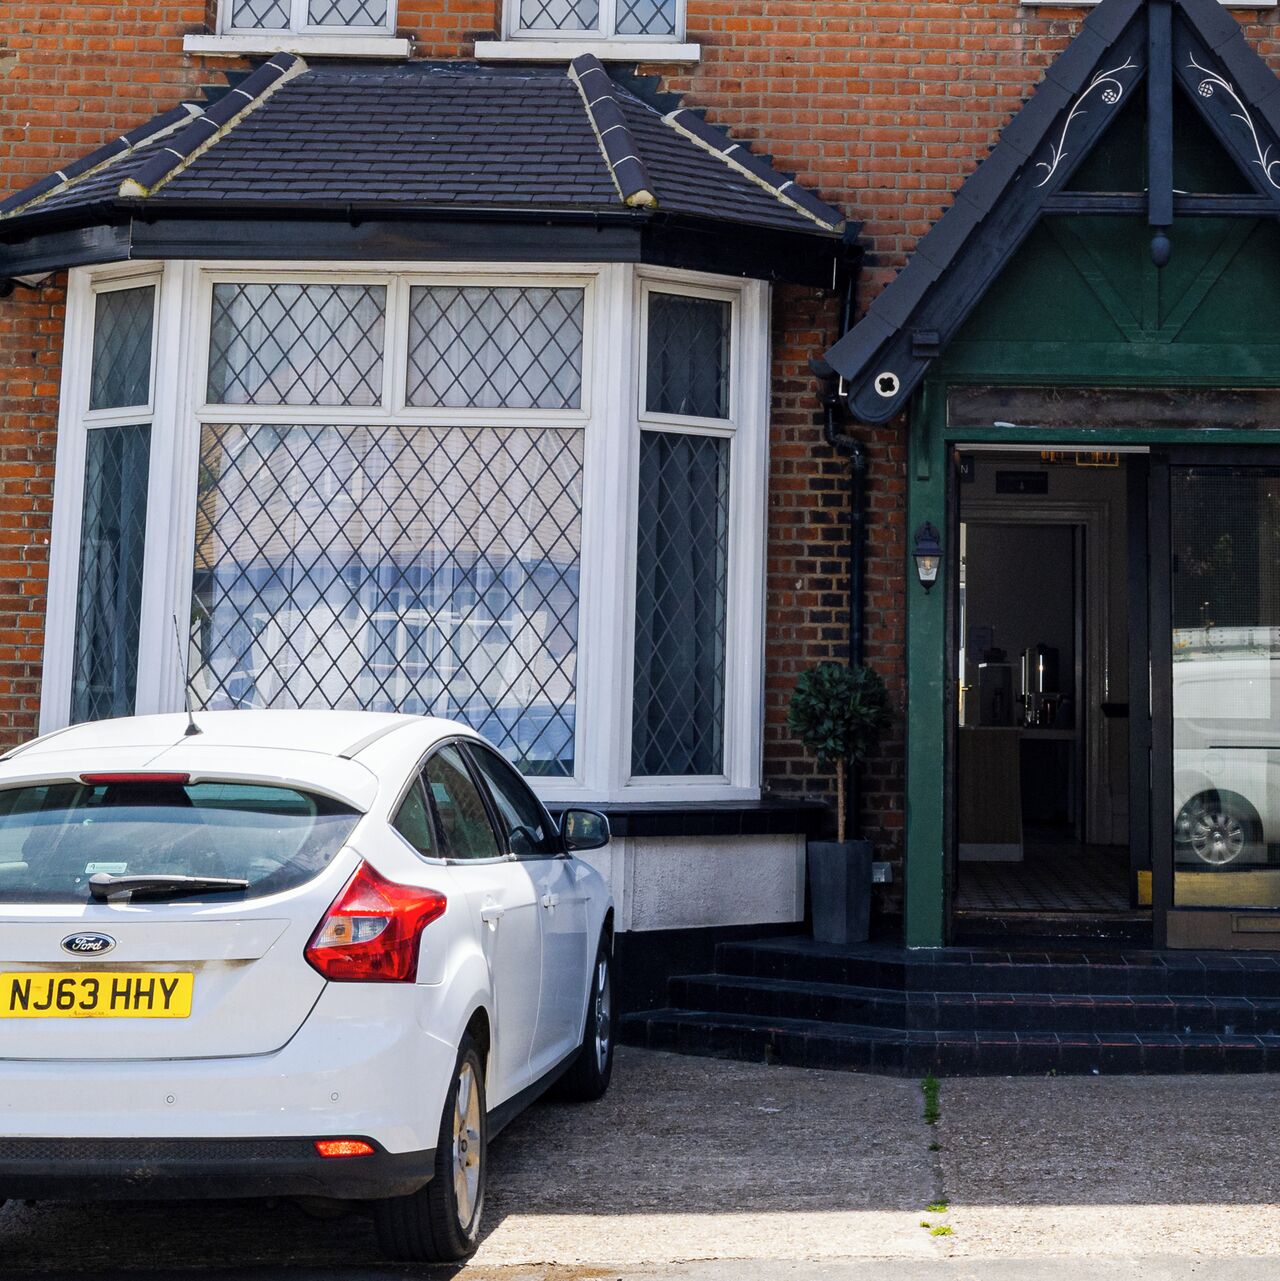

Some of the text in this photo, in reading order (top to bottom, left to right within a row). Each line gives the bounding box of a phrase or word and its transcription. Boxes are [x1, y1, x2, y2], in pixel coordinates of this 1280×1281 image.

[71, 937, 103, 951] Ford
[9, 978, 179, 1011] NJ63 HHY
